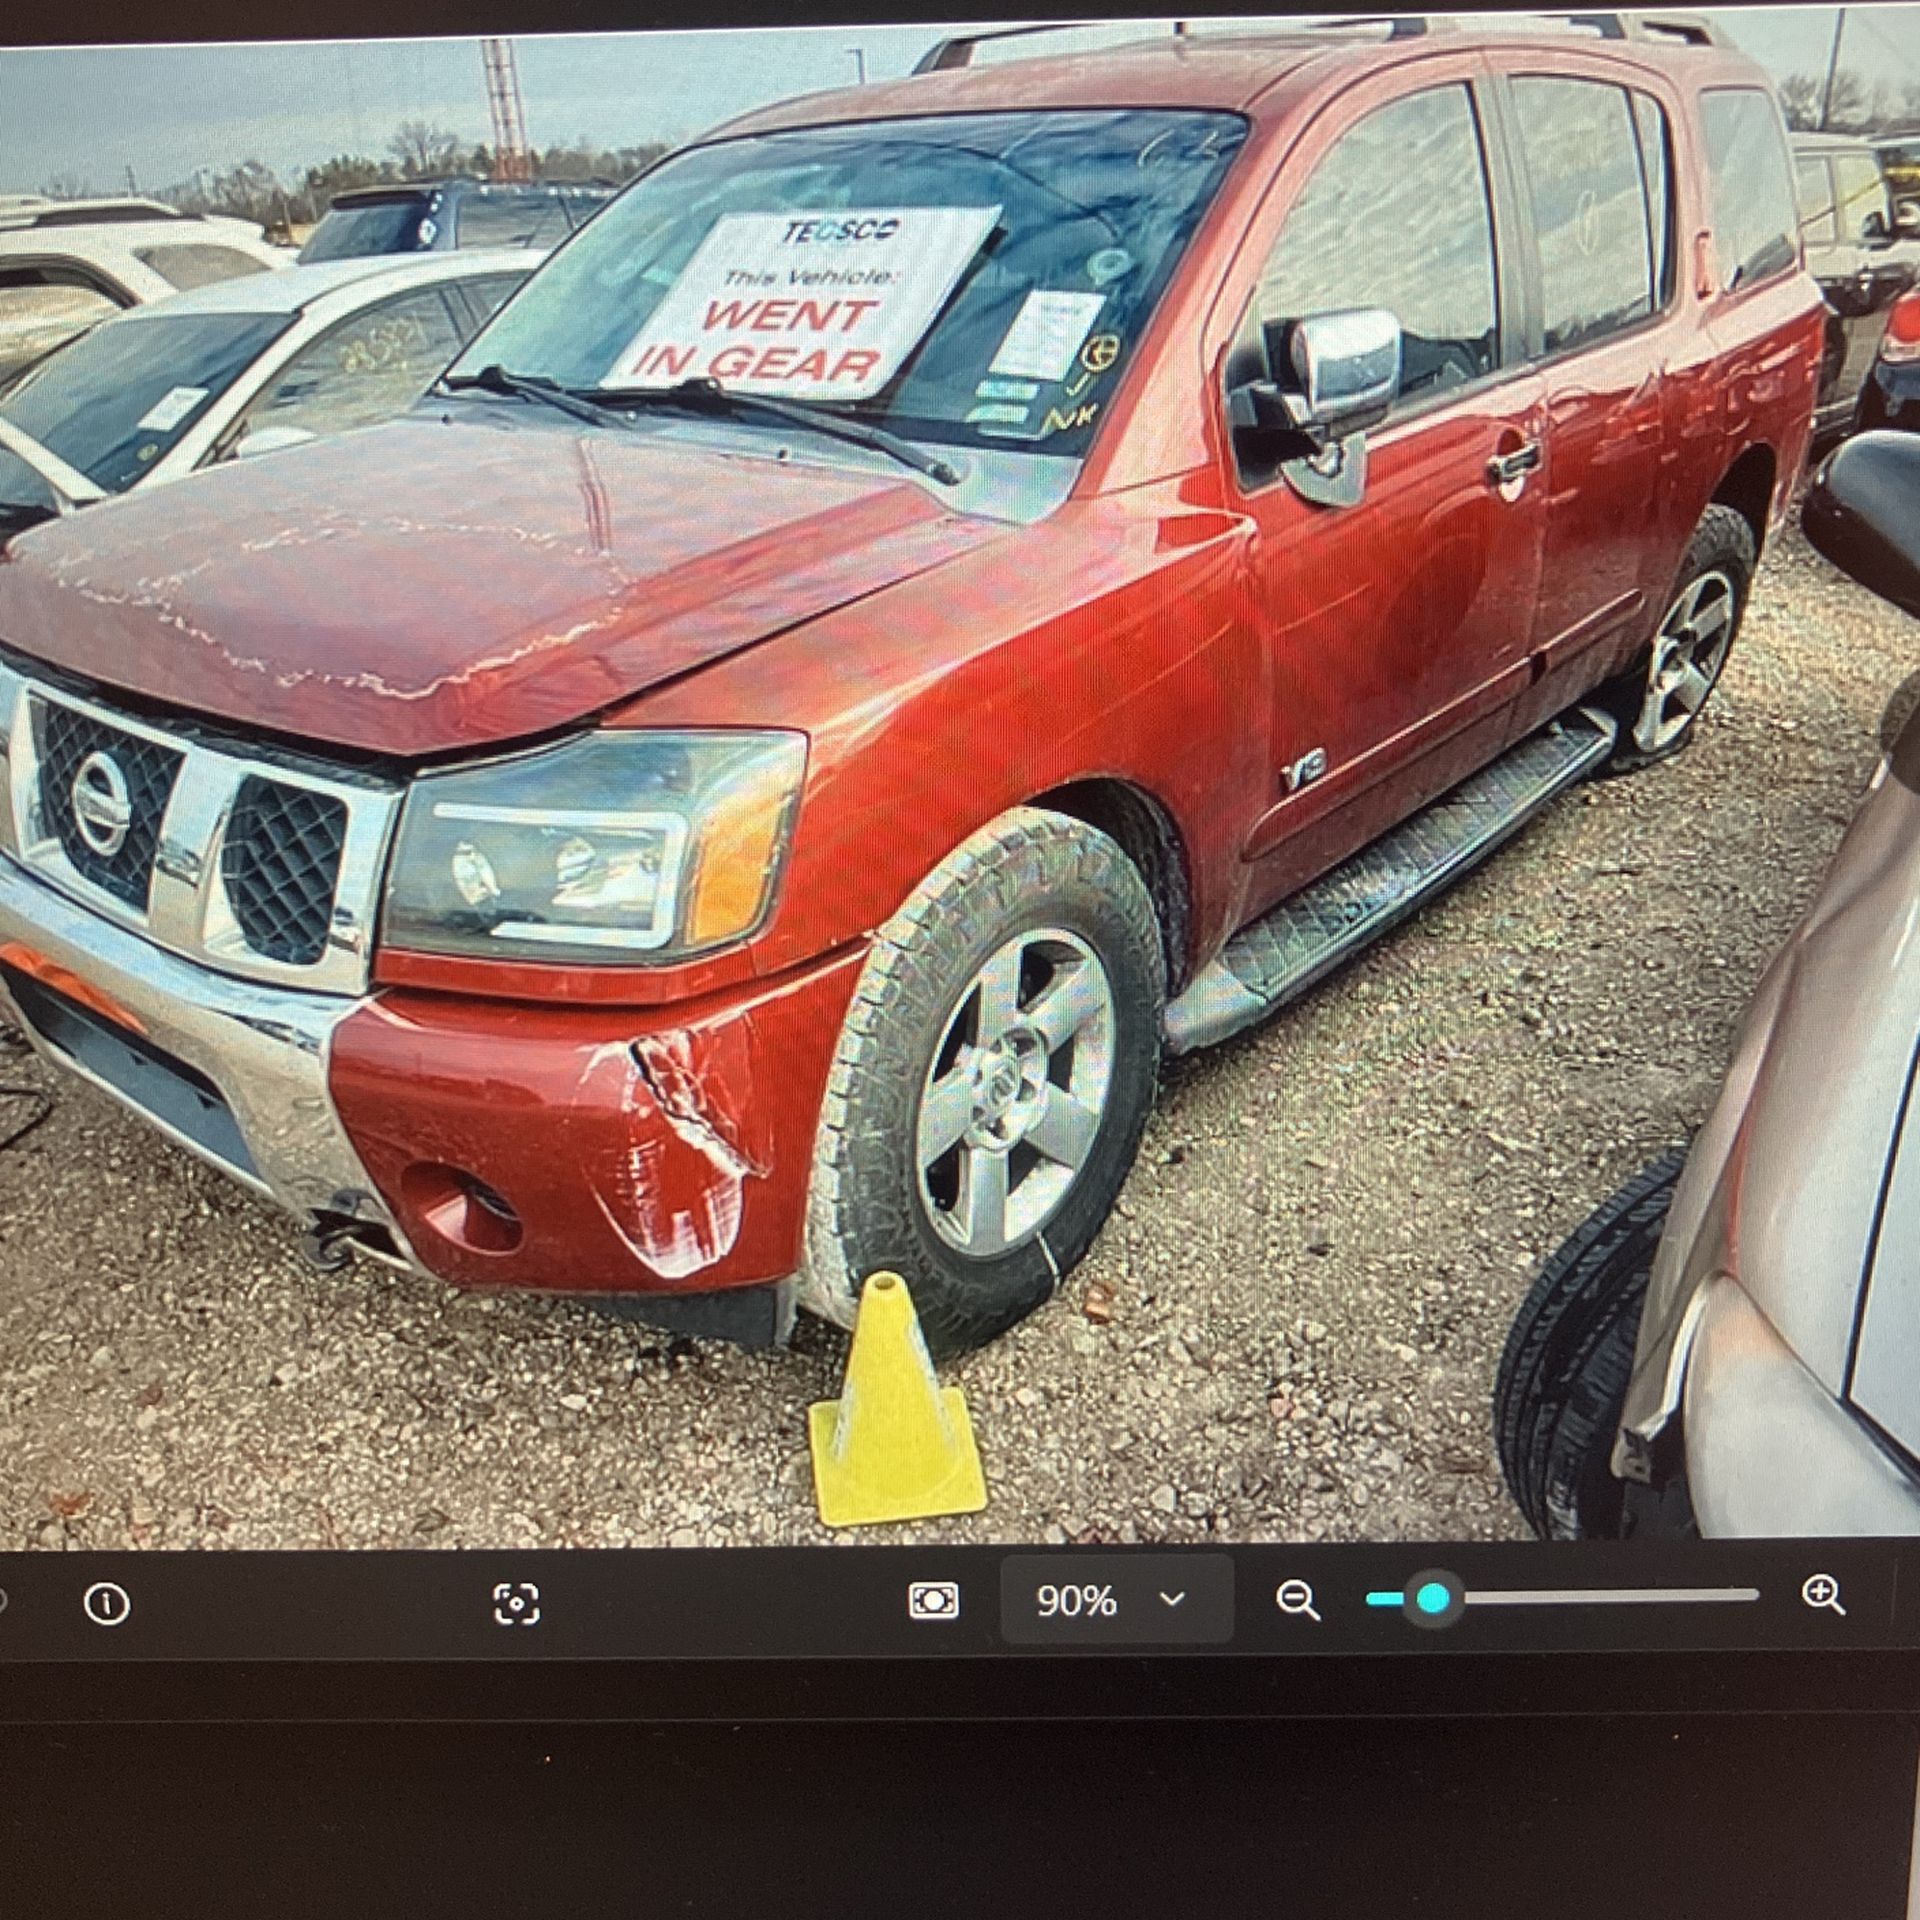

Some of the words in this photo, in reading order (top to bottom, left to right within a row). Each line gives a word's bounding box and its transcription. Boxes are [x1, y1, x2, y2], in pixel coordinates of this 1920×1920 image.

[724, 269, 777, 286] This
[789, 269, 902, 286] Vehicle:
[703, 299, 881, 333] WENT
[631, 345, 697, 377] IN
[707, 345, 882, 382] GEAR
[1037, 1584, 1118, 1616] 90%
